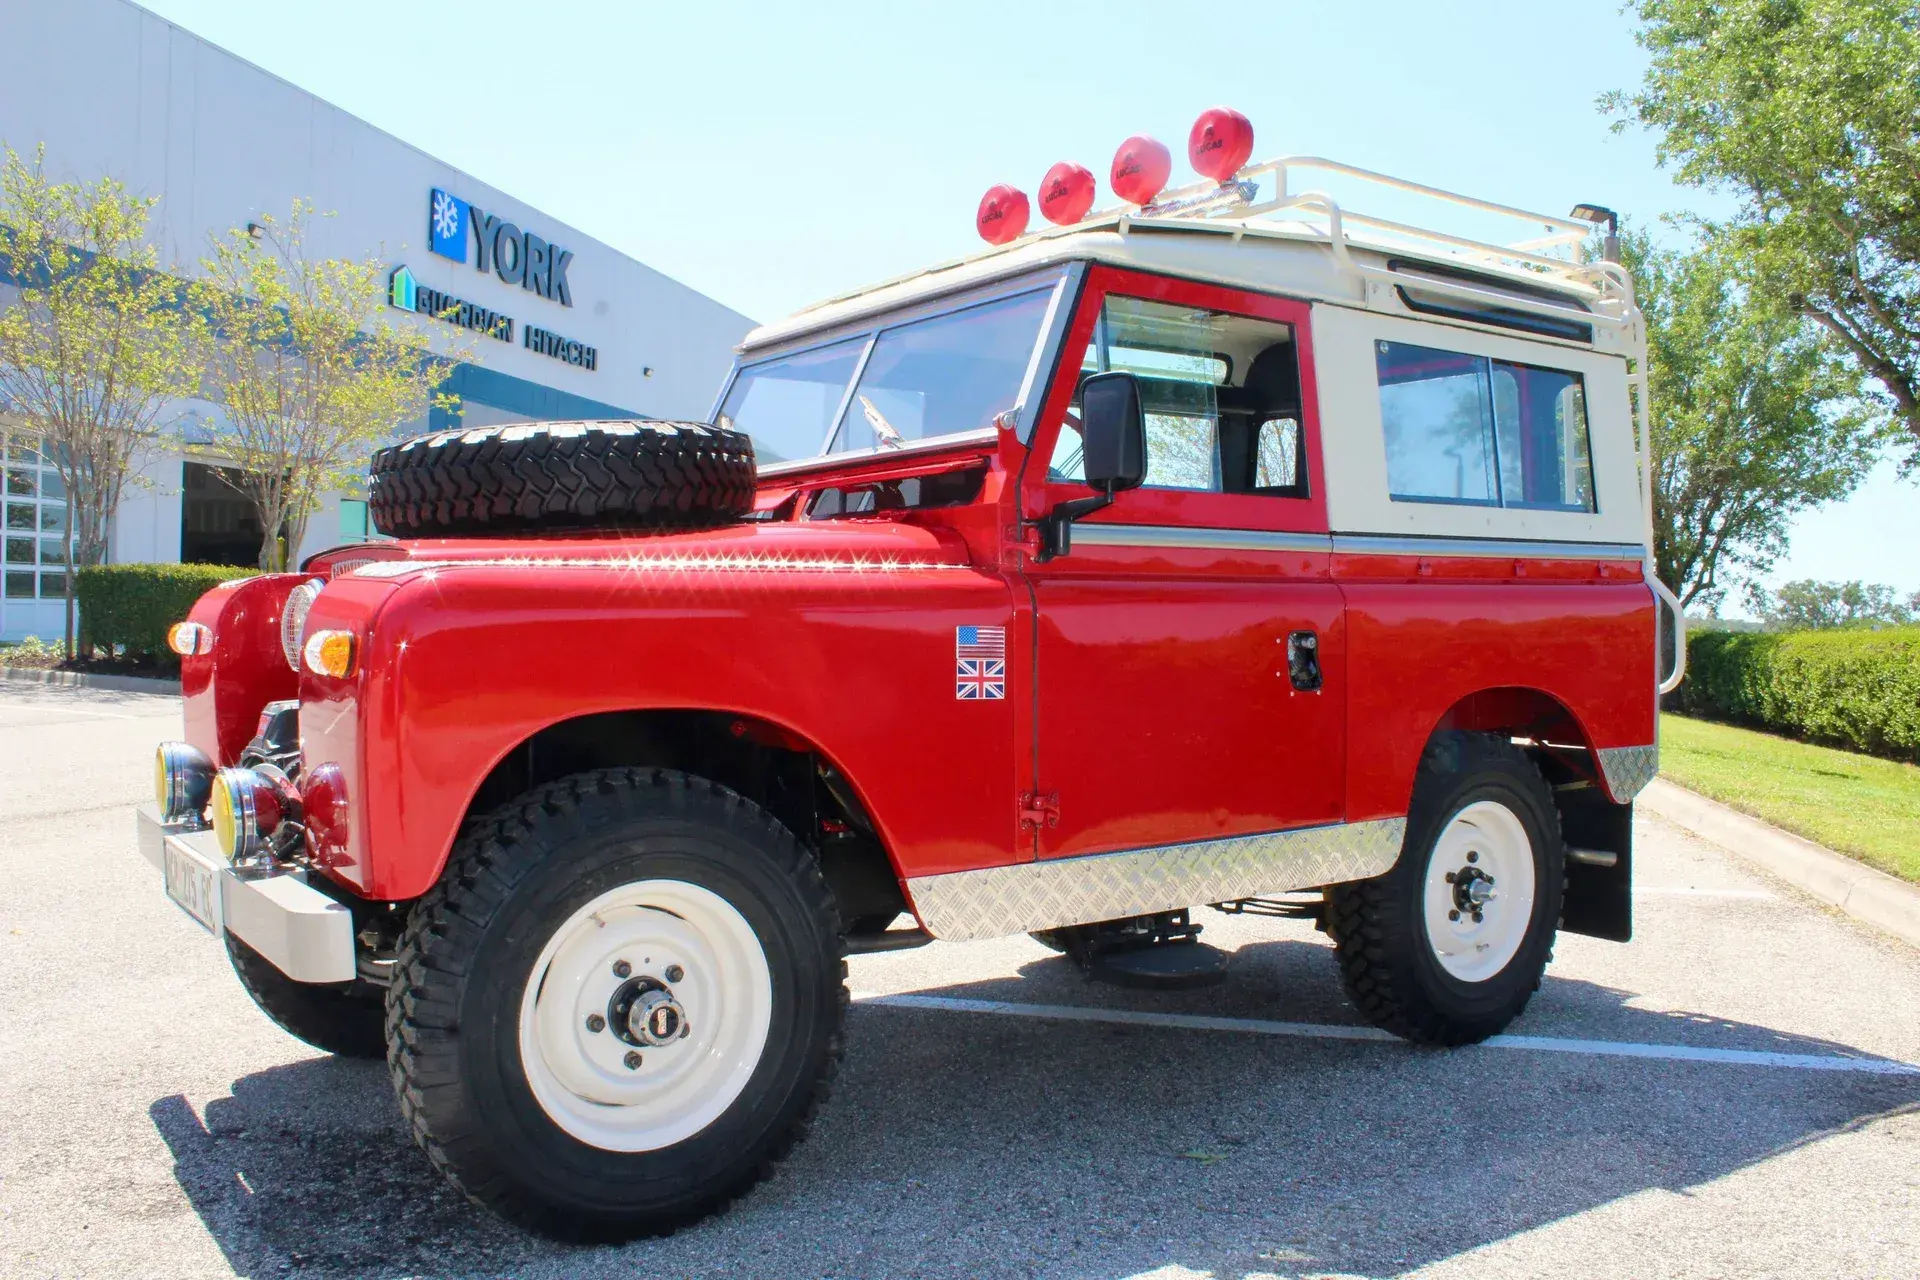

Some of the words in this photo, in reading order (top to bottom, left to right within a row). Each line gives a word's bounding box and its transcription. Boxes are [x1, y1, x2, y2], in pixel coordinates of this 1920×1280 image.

[1196, 139, 1223, 155] LUCAS
[1044, 187, 1069, 203] LUCAS
[469, 205, 574, 308] YORK
[416, 286, 515, 343] GUARDIAN
[525, 324, 598, 371] HITACHI
